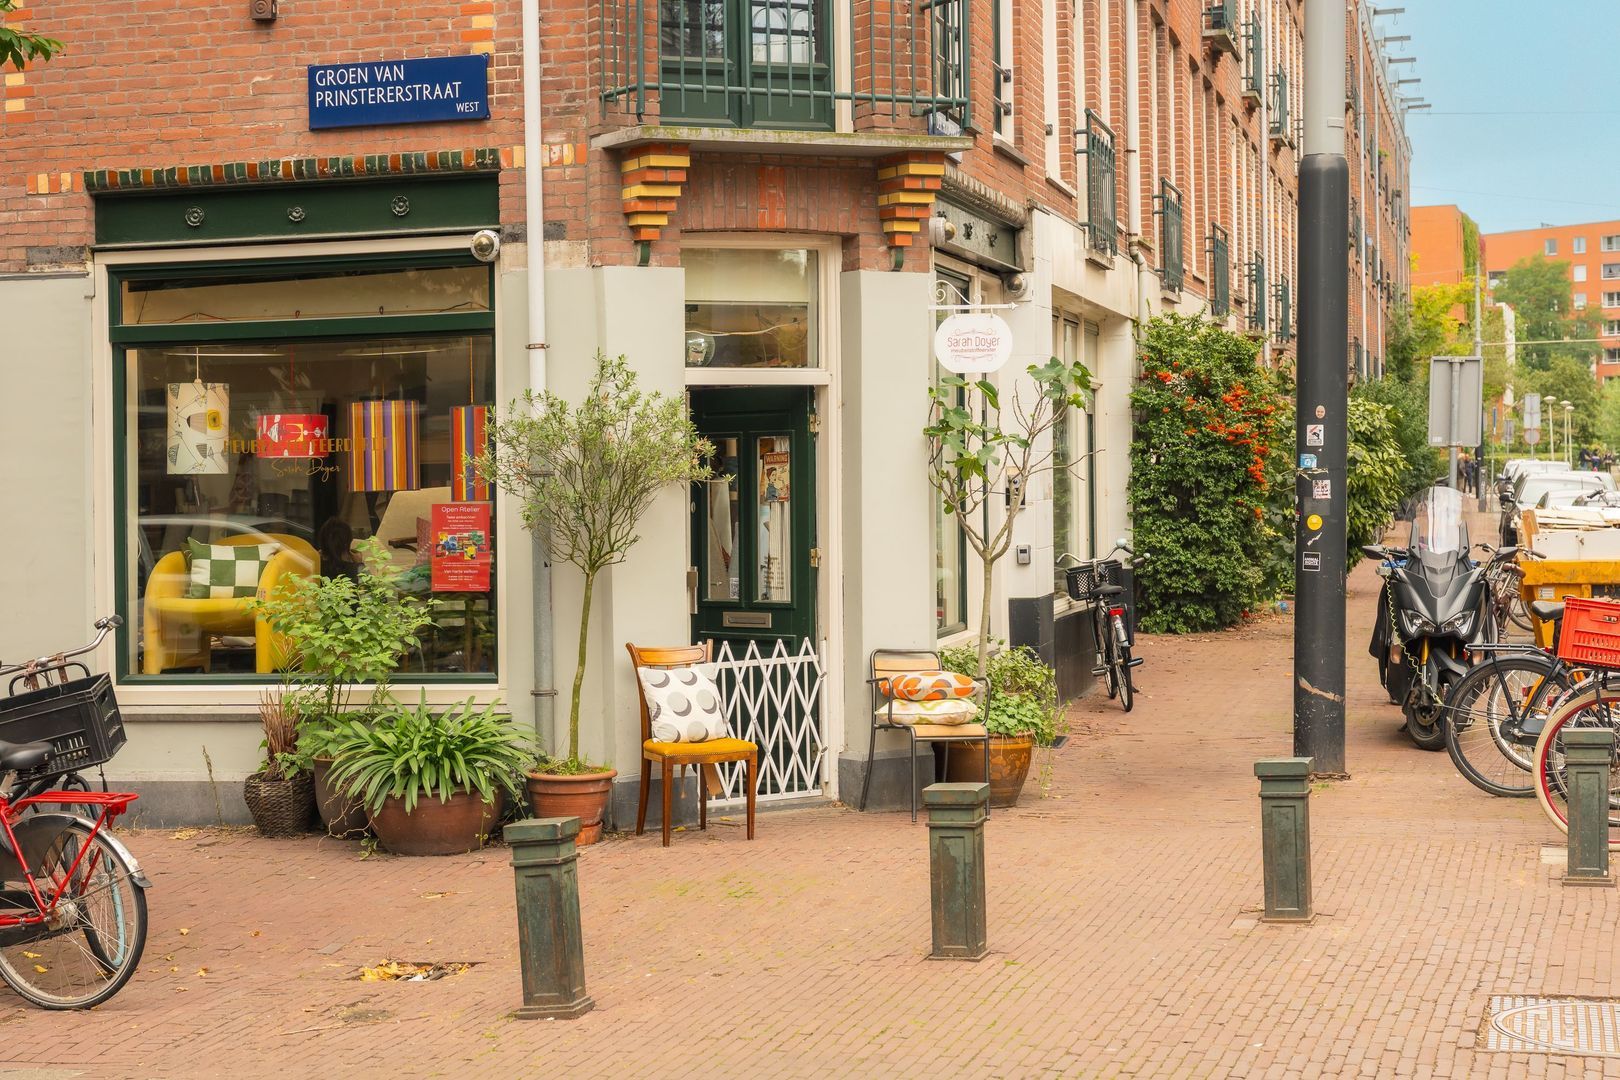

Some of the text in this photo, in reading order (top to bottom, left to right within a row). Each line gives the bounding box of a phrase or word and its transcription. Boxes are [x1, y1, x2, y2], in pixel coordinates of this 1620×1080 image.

[315, 64, 405, 87] GROEN VAN
[315, 81, 462, 108] PRINSTERERSTRAAT
[456, 101, 480, 113] WEST
[947, 336, 1001, 348] Sarah Doyer
[765, 453, 788, 463] WARNING
